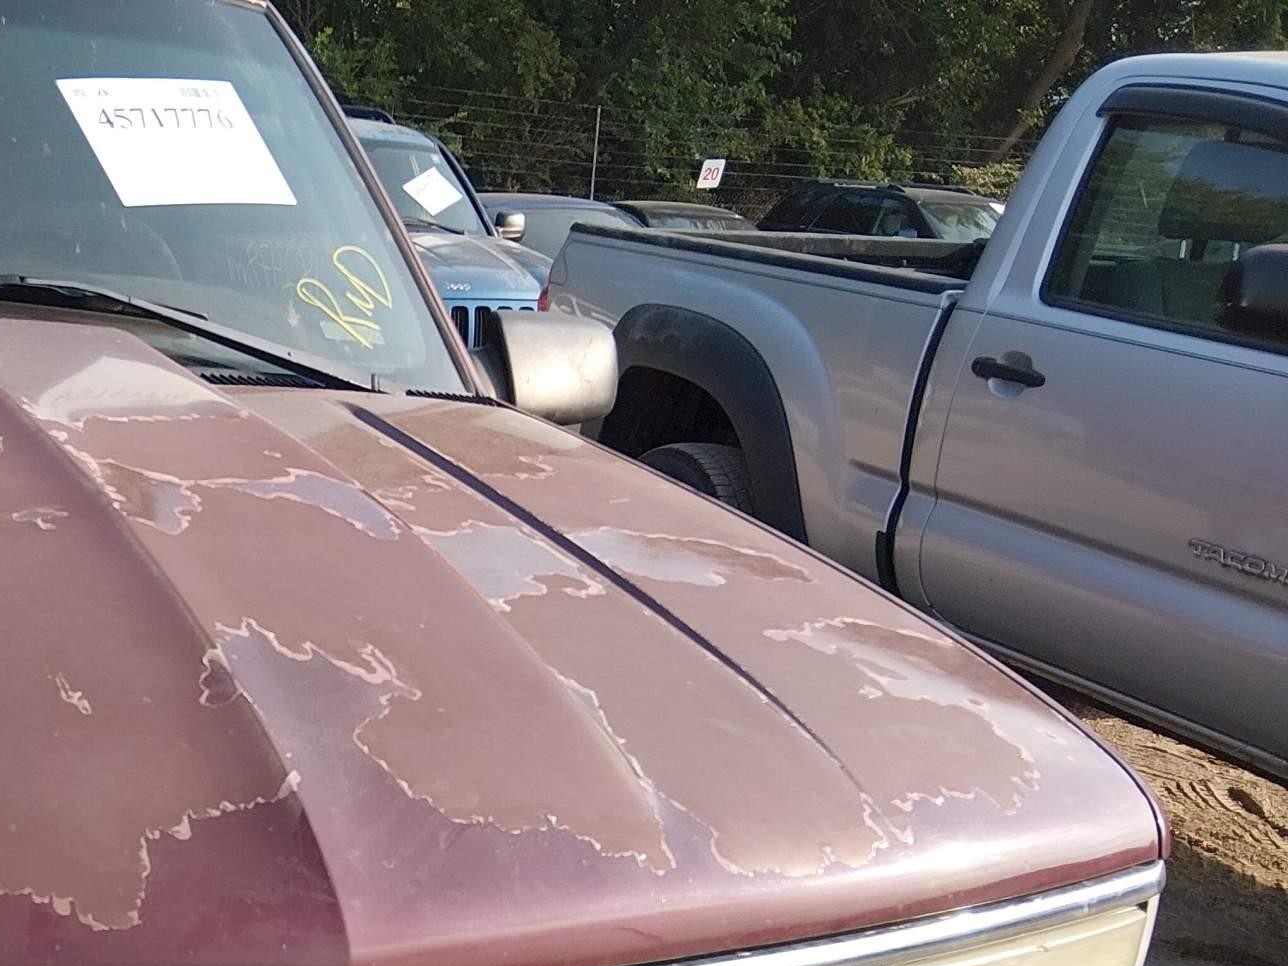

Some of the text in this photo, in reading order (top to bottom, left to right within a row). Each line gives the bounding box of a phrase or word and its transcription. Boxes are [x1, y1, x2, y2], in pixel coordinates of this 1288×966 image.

[97, 107, 235, 130] 45717776
[702, 167, 720, 181] 20
[1188, 537, 1288, 585] TACOM
